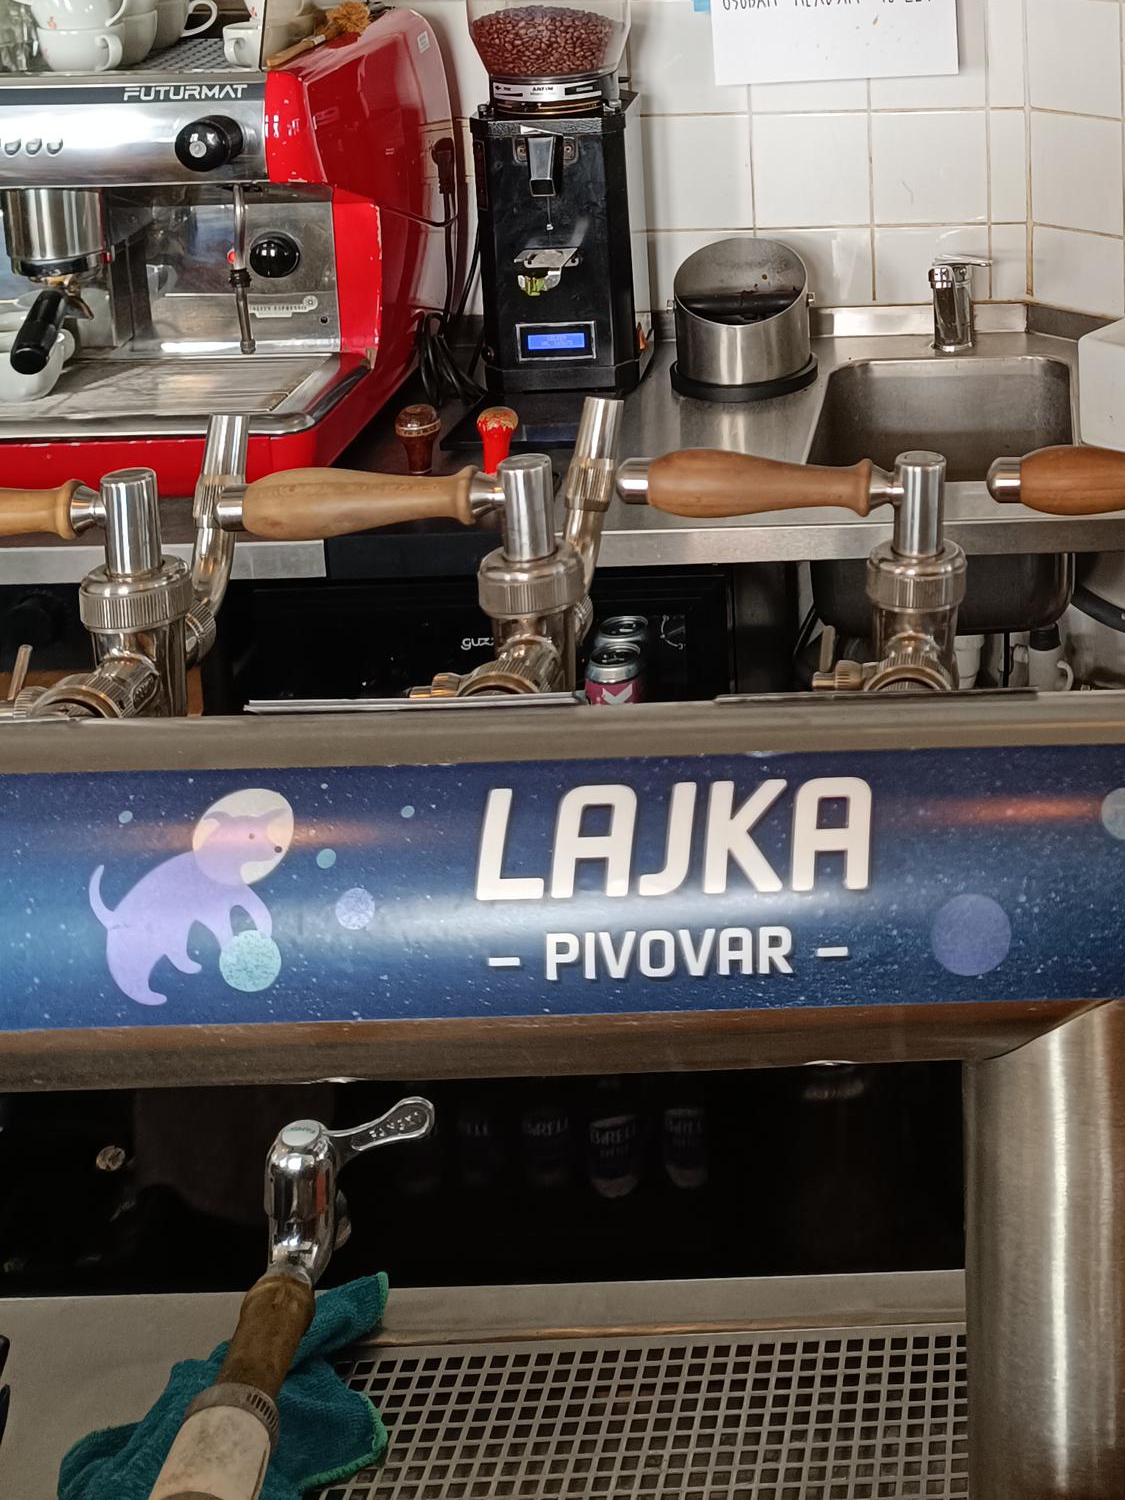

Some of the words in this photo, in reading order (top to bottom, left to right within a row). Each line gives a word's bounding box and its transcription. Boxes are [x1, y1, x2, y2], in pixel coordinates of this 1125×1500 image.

[123, 83, 248, 101] FUTURMAT
[475, 776, 873, 901] LAJKA
[545, 926, 794, 981] PIVOVAR
